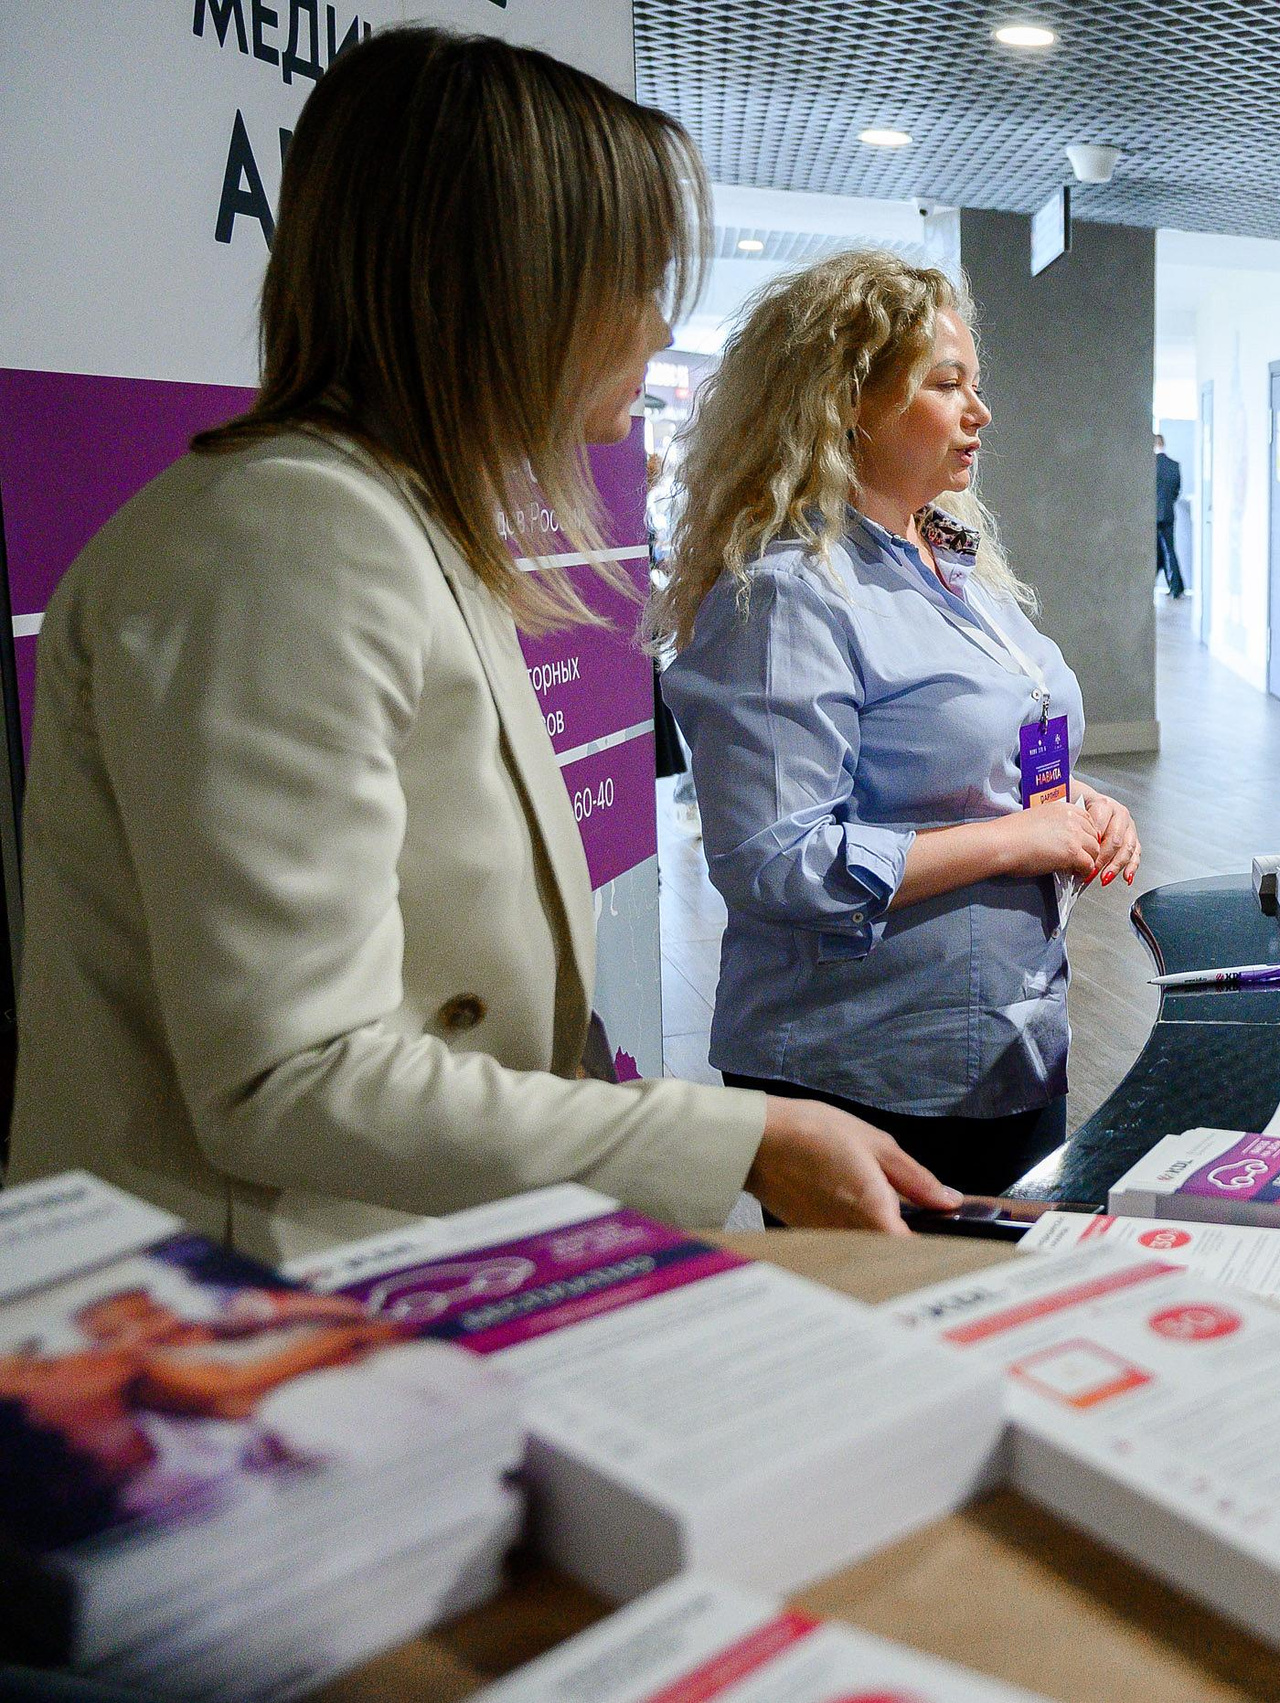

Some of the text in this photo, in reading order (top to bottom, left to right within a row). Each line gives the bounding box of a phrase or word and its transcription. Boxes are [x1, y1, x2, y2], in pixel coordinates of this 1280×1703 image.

[192, 0, 372, 85] МЕДИ
[214, 108, 293, 253] А
[542, 710, 565, 737] ов
[574, 777, 614, 822] 60-40
